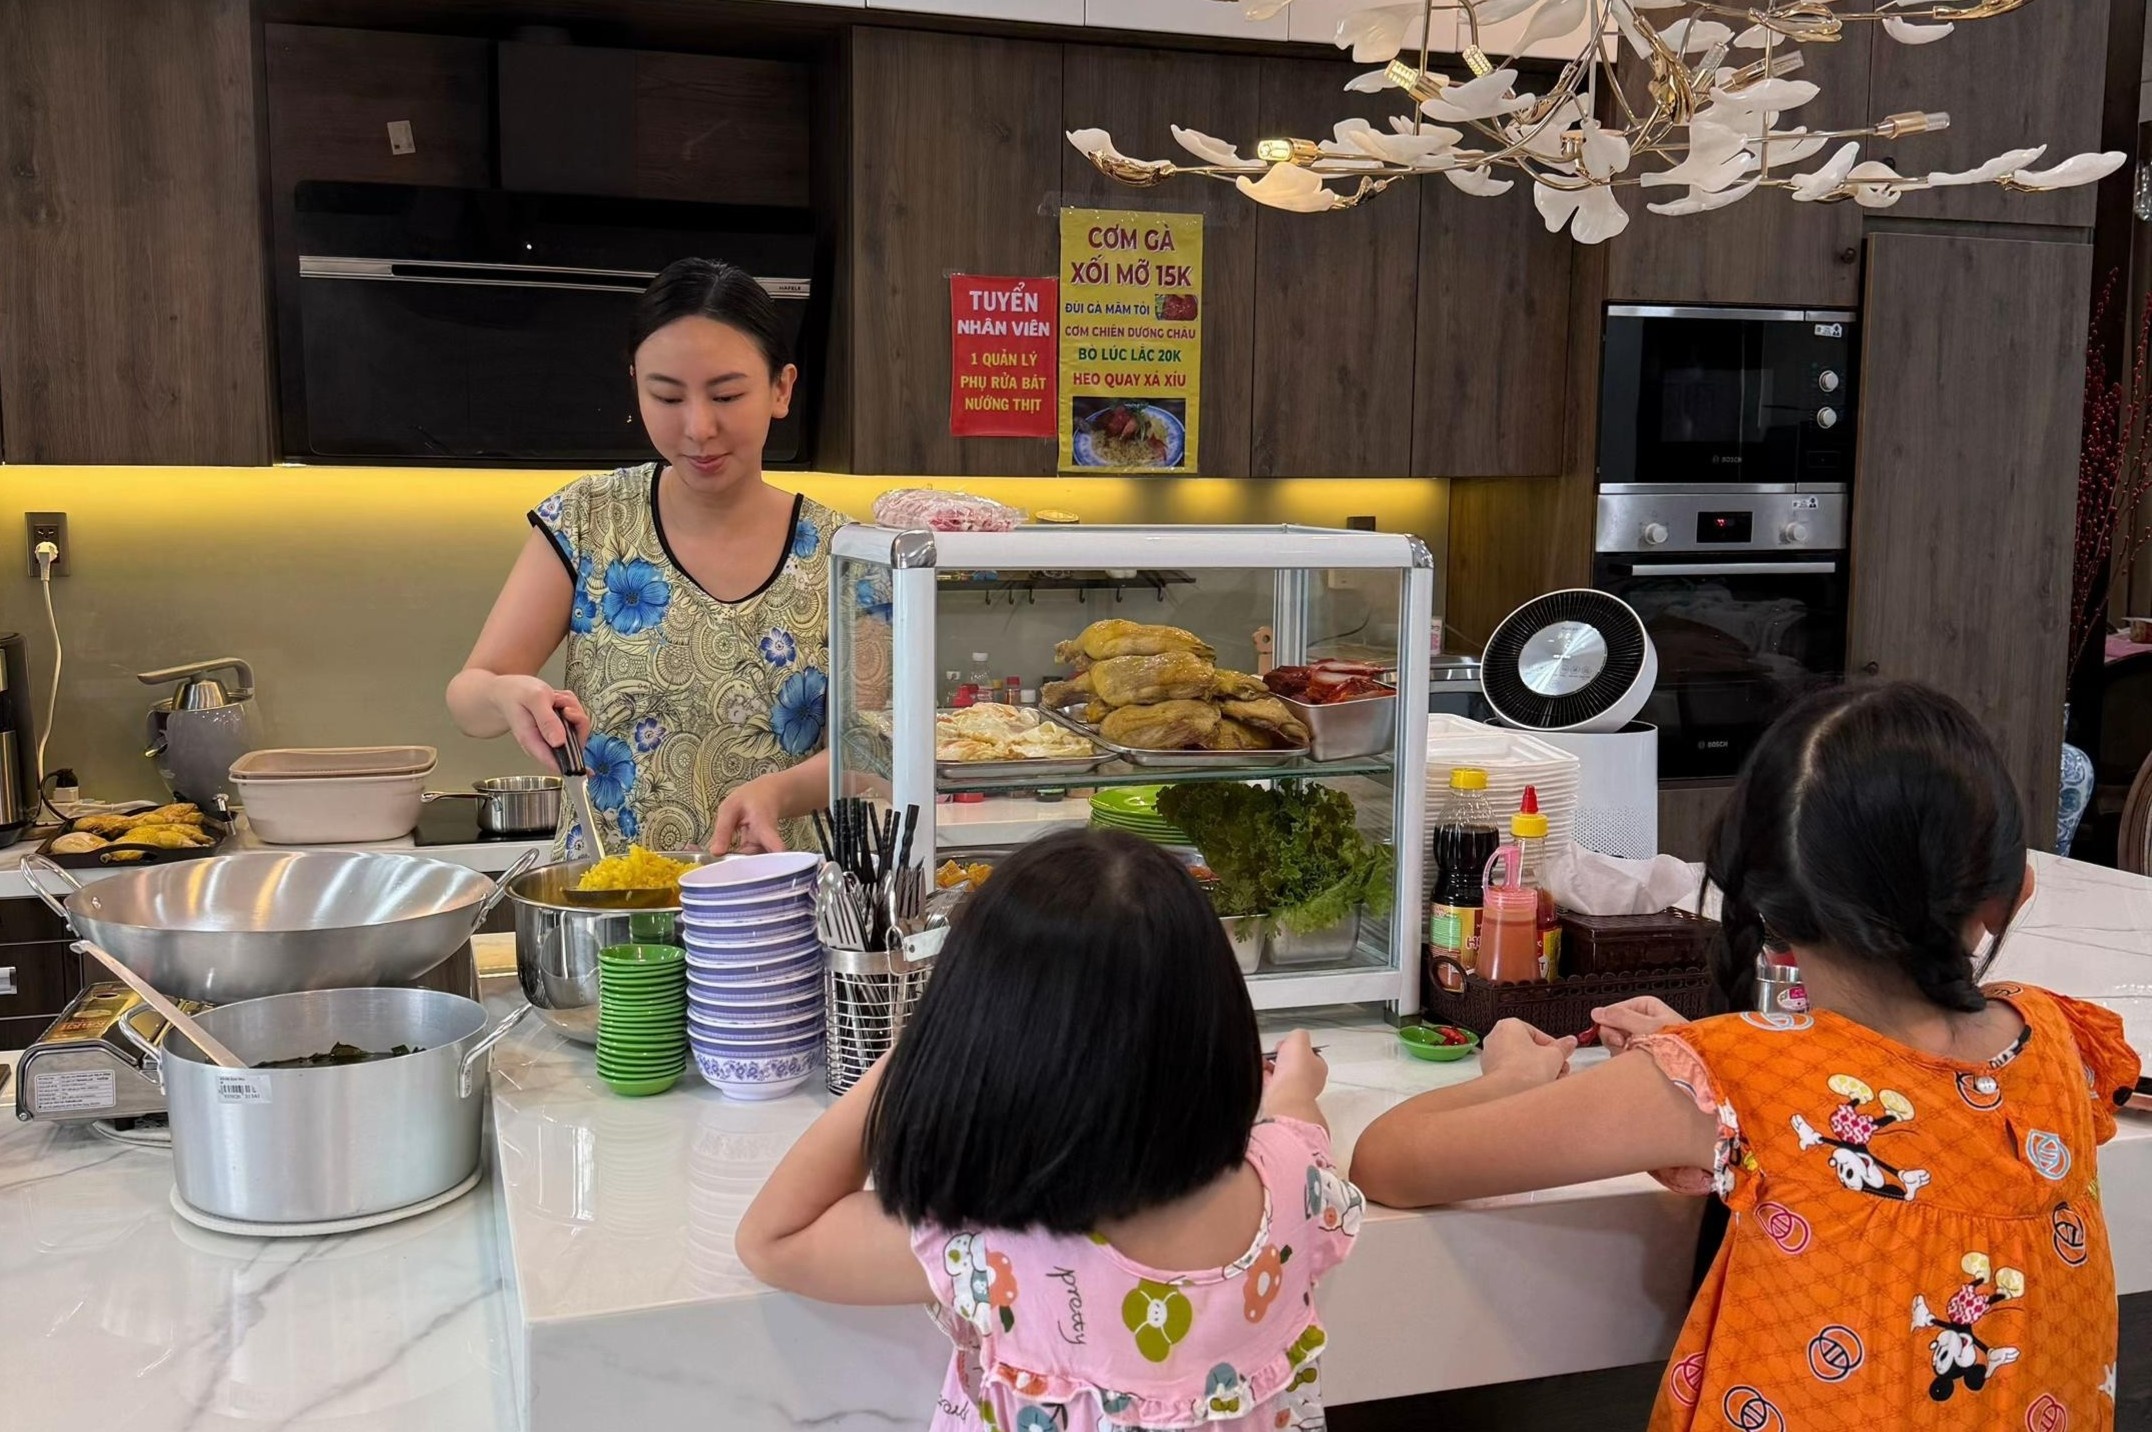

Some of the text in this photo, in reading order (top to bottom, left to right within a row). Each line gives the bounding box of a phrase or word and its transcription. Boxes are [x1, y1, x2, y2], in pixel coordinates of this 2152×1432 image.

[1088, 224, 1176, 251] CƠM GÀ
[1071, 254, 1192, 287] XỐI MỠ 15K
[969, 281, 1038, 313] TUYỂN
[957, 317, 1050, 337] NHÂN VIÊN
[1065, 323, 1196, 339] CƠM CHIÊN DƯƠNG CHÂU
[971, 348, 1037, 368] 1 QUẢN LÝ
[1078, 343, 1182, 363] BÒ LÚC LẮC 20K
[960, 371, 1046, 392] PHỤ RỬA BÁT
[1073, 373, 1101, 386] HEO
[1104, 373, 1141, 388] QUAY
[1164, 371, 1186, 387] XÍU
[965, 394, 1042, 414] NƯỚNG THỊT
[1045, 1265, 1087, 1345] pretty
